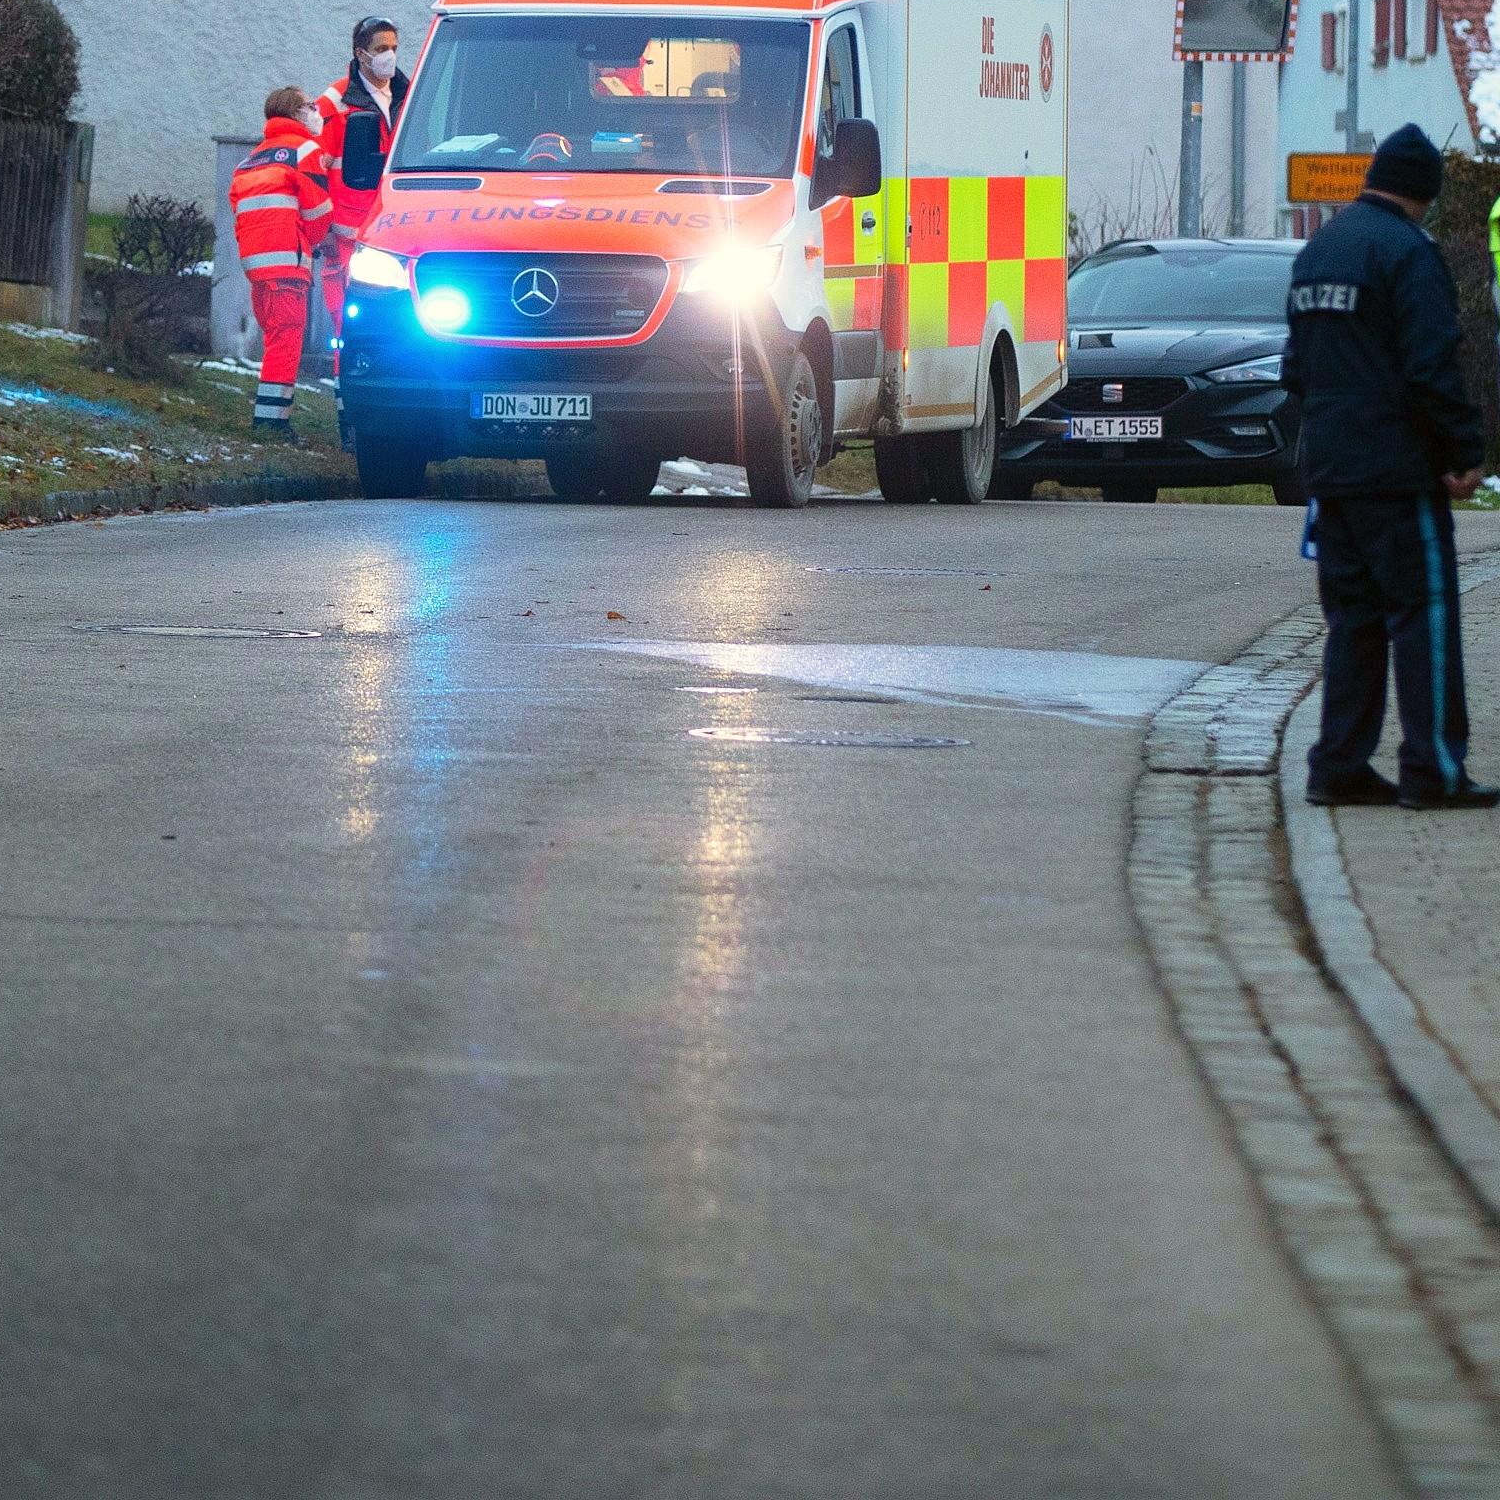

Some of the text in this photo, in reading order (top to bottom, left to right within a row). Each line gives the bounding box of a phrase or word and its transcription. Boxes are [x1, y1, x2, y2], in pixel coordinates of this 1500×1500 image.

[982, 16, 995, 55] DIE
[979, 59, 1030, 101] JOHANNITER
[376, 206, 743, 233] RETTUNGSDIENST
[483, 396, 589, 417] DON JU 711
[1073, 420, 1159, 436] N ET 1555
